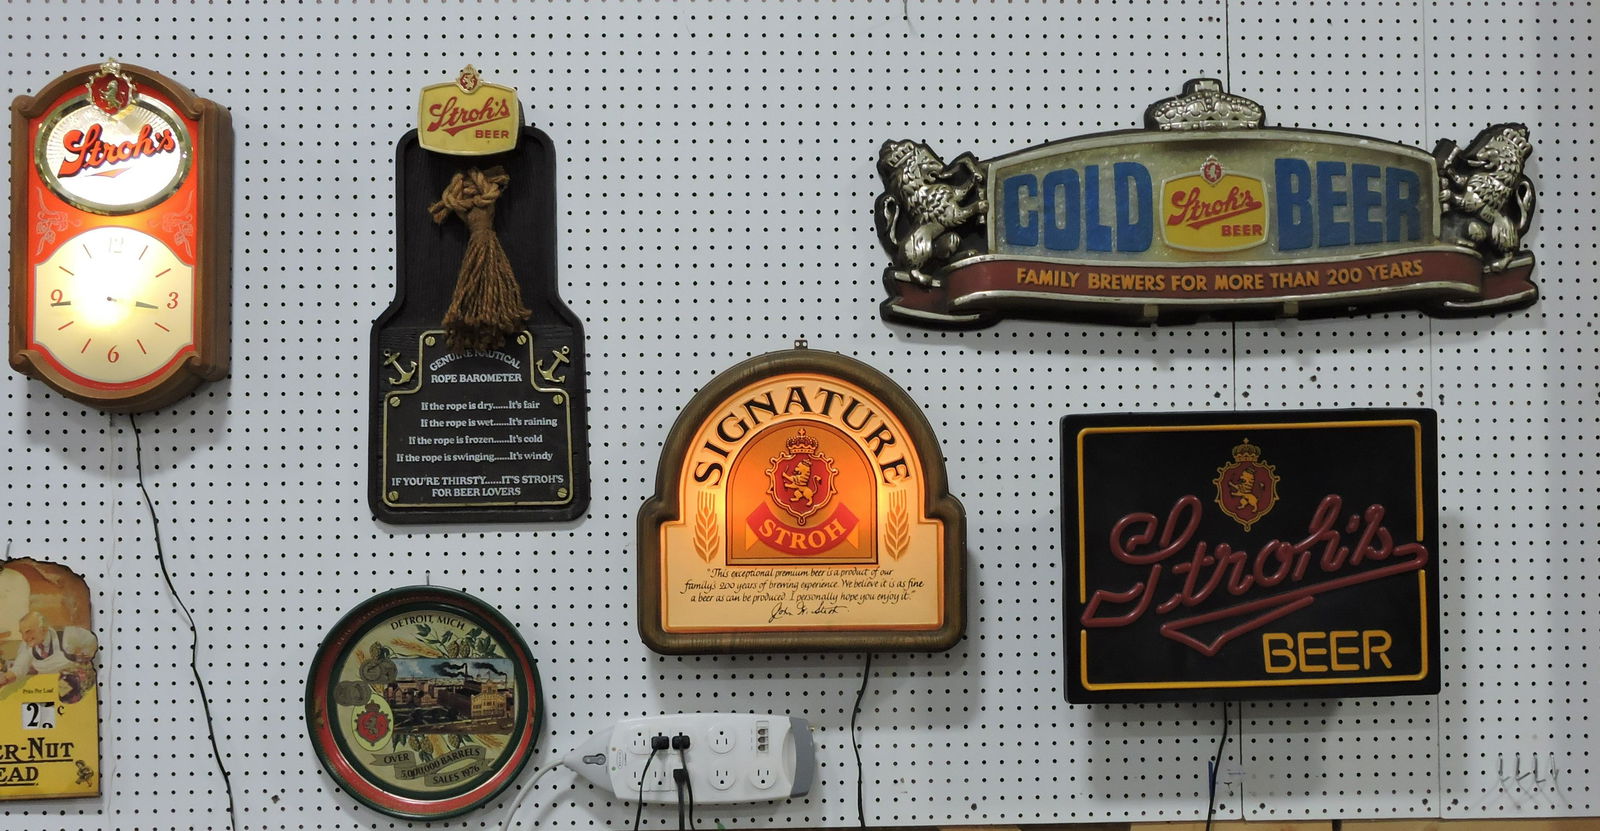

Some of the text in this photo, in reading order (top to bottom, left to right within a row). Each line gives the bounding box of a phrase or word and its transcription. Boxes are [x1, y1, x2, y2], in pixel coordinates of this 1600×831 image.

[427, 96, 510, 134] Stroh's
[475, 129, 509, 139] BEER
[57, 123, 176, 178] Stroh's
[1003, 158, 1420, 252] COLD BEER
[1167, 186, 1262, 228] Stroh's
[1221, 224, 1263, 237] BEER
[1017, 259, 1424, 291] FAMILY BREWERS FOR MORE THAN 200 YEARS
[167, 291, 179, 309] 3
[107, 345, 119, 363] 6
[431, 373, 522, 383] ROPE BAROMETER
[421, 401, 429, 411] If
[430, 401, 445, 411] the
[446, 403, 467, 412] rope
[468, 401, 477, 410] is
[523, 401, 540, 409] fair
[420, 418, 428, 428] If
[429, 418, 445, 428] the
[445, 420, 467, 429] rope
[468, 418, 476, 427] is
[523, 417, 558, 427] raining
[408, 435, 416, 445] If
[417, 435, 432, 445] the
[433, 437, 455, 446] rope
[456, 435, 464, 444] is
[523, 434, 543, 443] cold
[693, 386, 912, 488] SIGNATURE
[396, 453, 404, 462] If
[405, 453, 420, 462] the
[421, 455, 442, 463] rope
[443, 453, 451, 461] is
[523, 451, 554, 461] windy
[392, 477, 401, 486] IF
[403, 477, 440, 486] YOU'RE
[521, 474, 564, 484] STROH'S
[432, 487, 521, 497] FOR BEER LOVERS
[758, 518, 846, 549] STROH
[731, 567, 773, 579] exceptional
[774, 568, 808, 579] premium
[811, 568, 825, 576] beer
[826, 567, 833, 576] is
[839, 566, 868, 578] product
[869, 566, 880, 579] of
[1081, 494, 1428, 640] Stroh's
[734, 582, 757, 593] years
[758, 579, 768, 593] of
[769, 579, 799, 592] brewing
[841, 578, 853, 588] We
[853, 578, 878, 588] believe
[880, 578, 887, 587] it
[888, 578, 895, 587] is
[904, 578, 924, 591] fine
[698, 592, 713, 602] beer
[742, 592, 751, 602] be
[796, 592, 838, 605] personally
[840, 591, 858, 603] hope
[858, 594, 875, 605] you
[877, 592, 899, 605] enjoy
[391, 615, 433, 630] DETROIT,
[1262, 630, 1392, 673] BEER
[384, 752, 410, 764] OVER
[440, 747, 480, 765] BARRELS
[432, 765, 480, 785] SALES 1976
